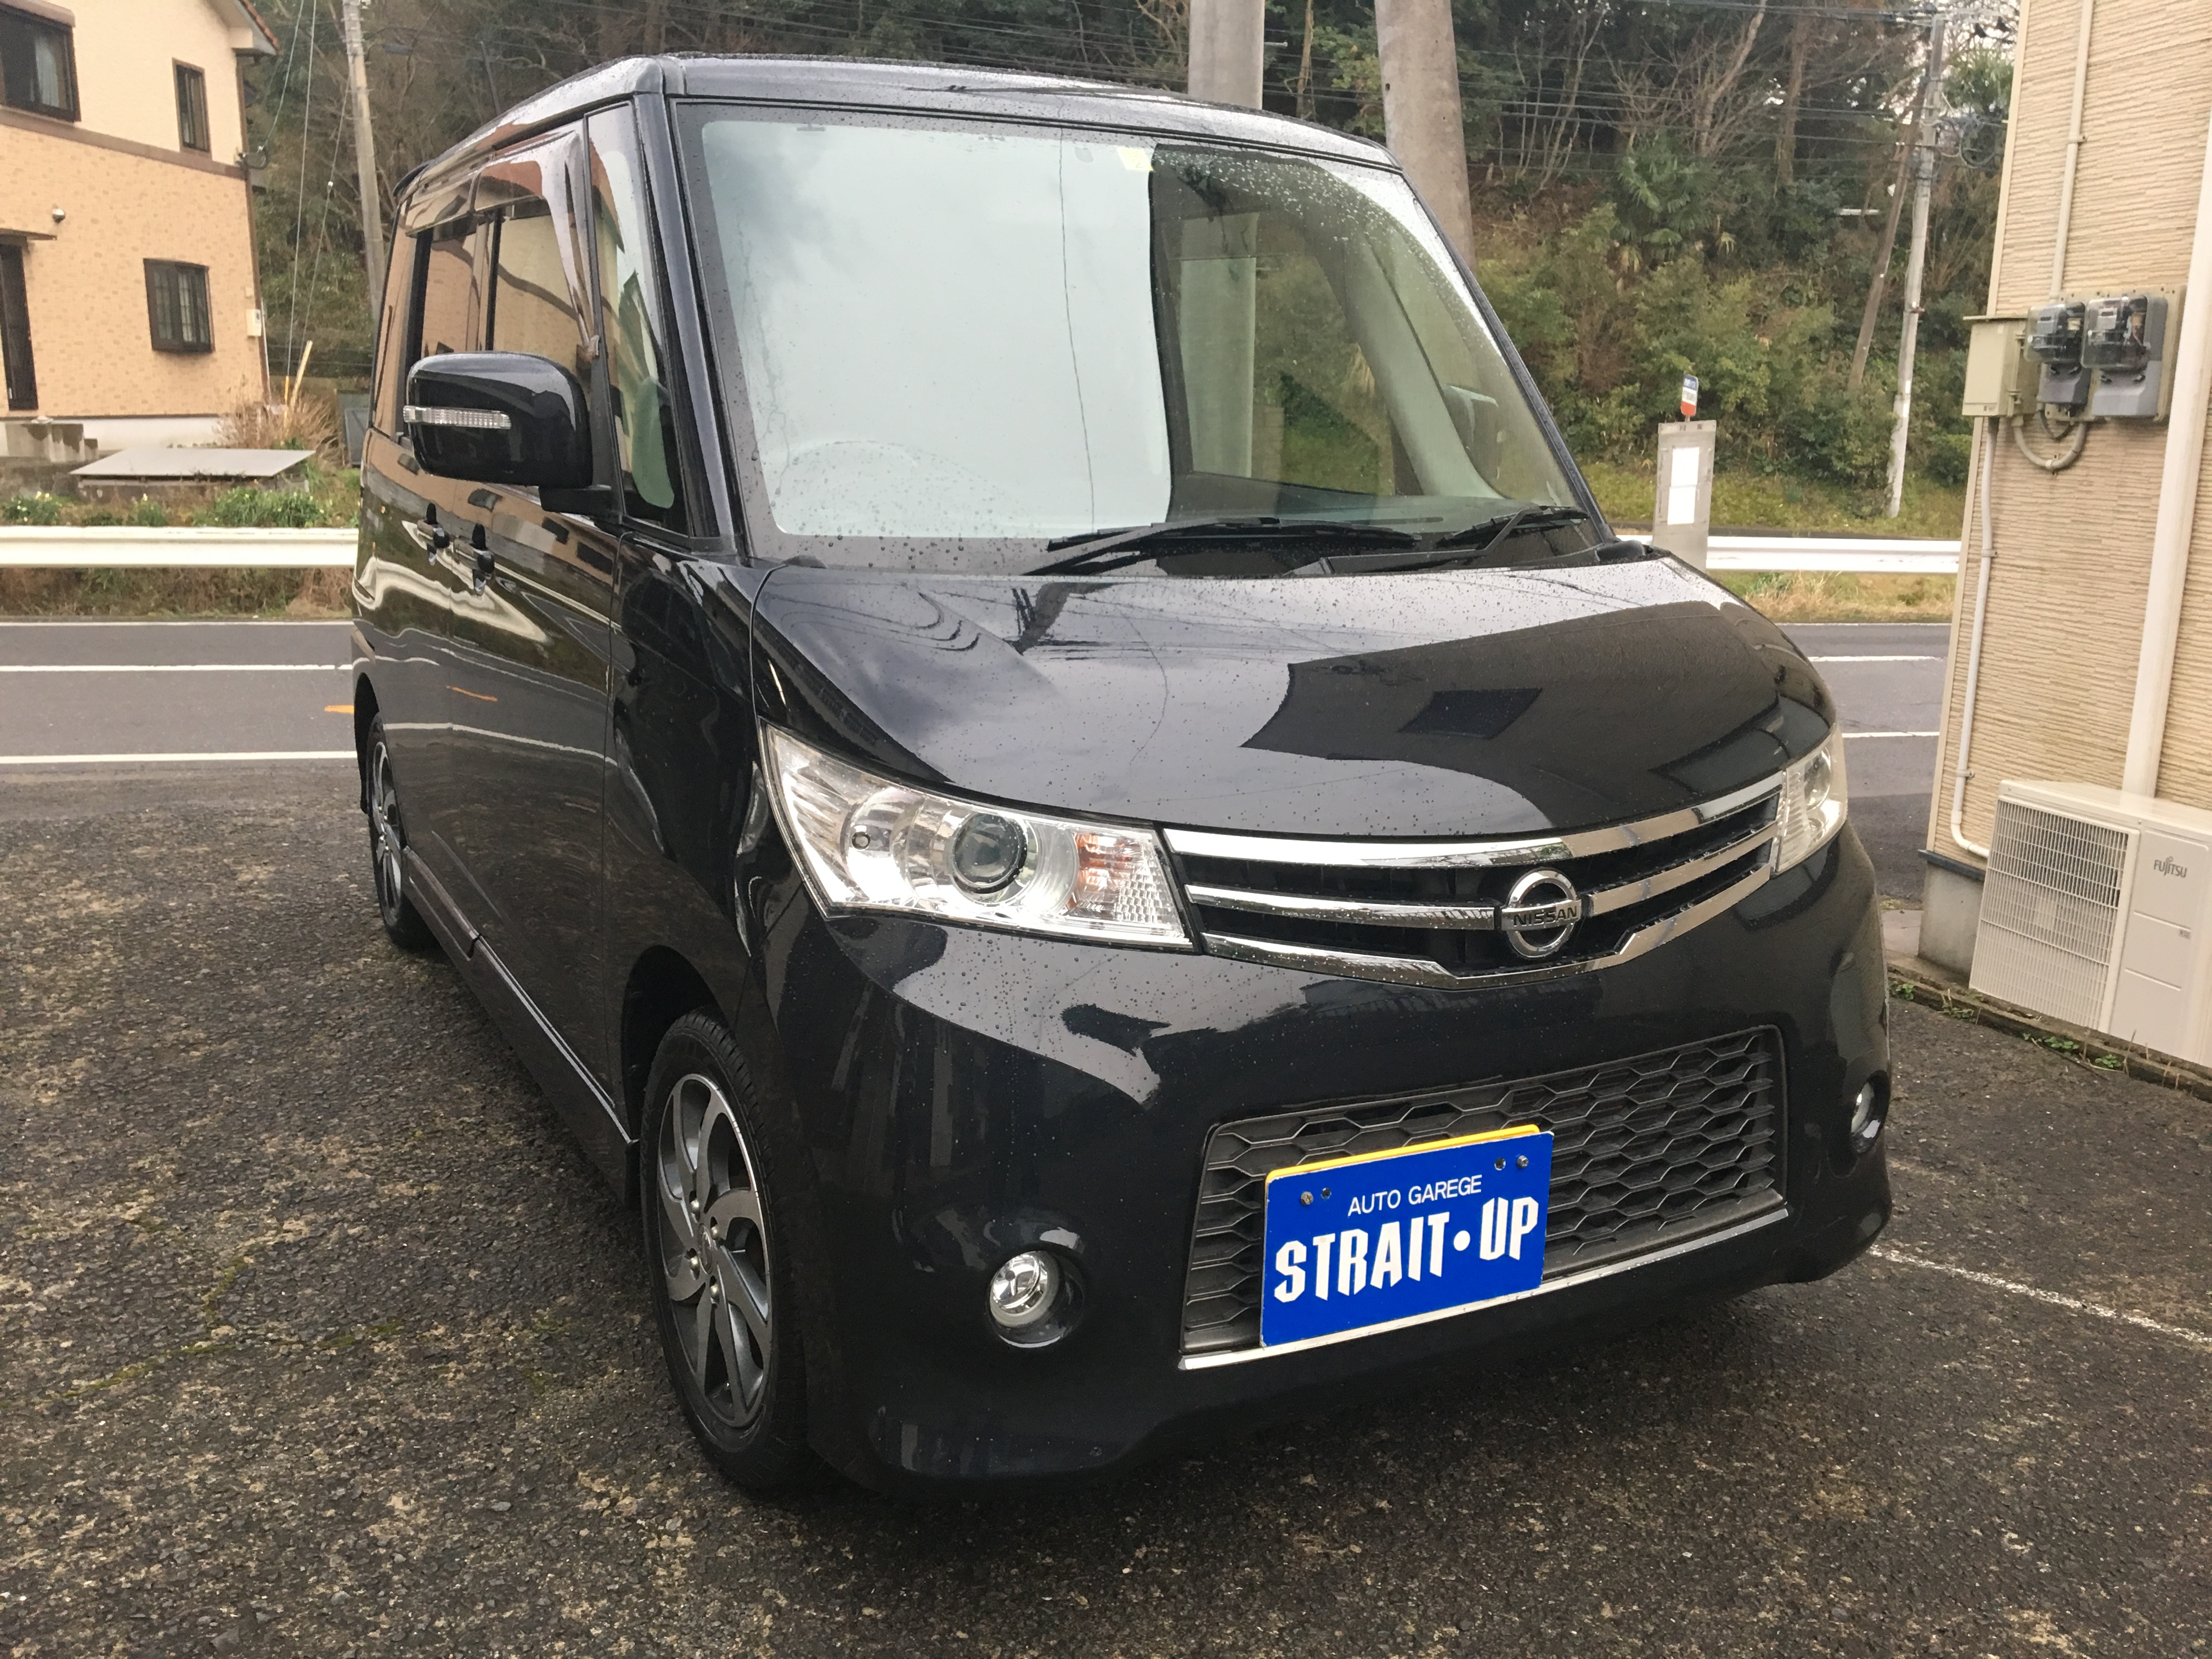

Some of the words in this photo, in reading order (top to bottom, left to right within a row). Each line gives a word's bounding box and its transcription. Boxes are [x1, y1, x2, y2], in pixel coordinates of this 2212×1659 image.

[2153, 856, 2187, 878] FUJITSU
[1513, 906, 1577, 927] NISSAN
[1347, 1189, 1401, 1217] AUTO
[1408, 1175, 1483, 1205] GAREGE
